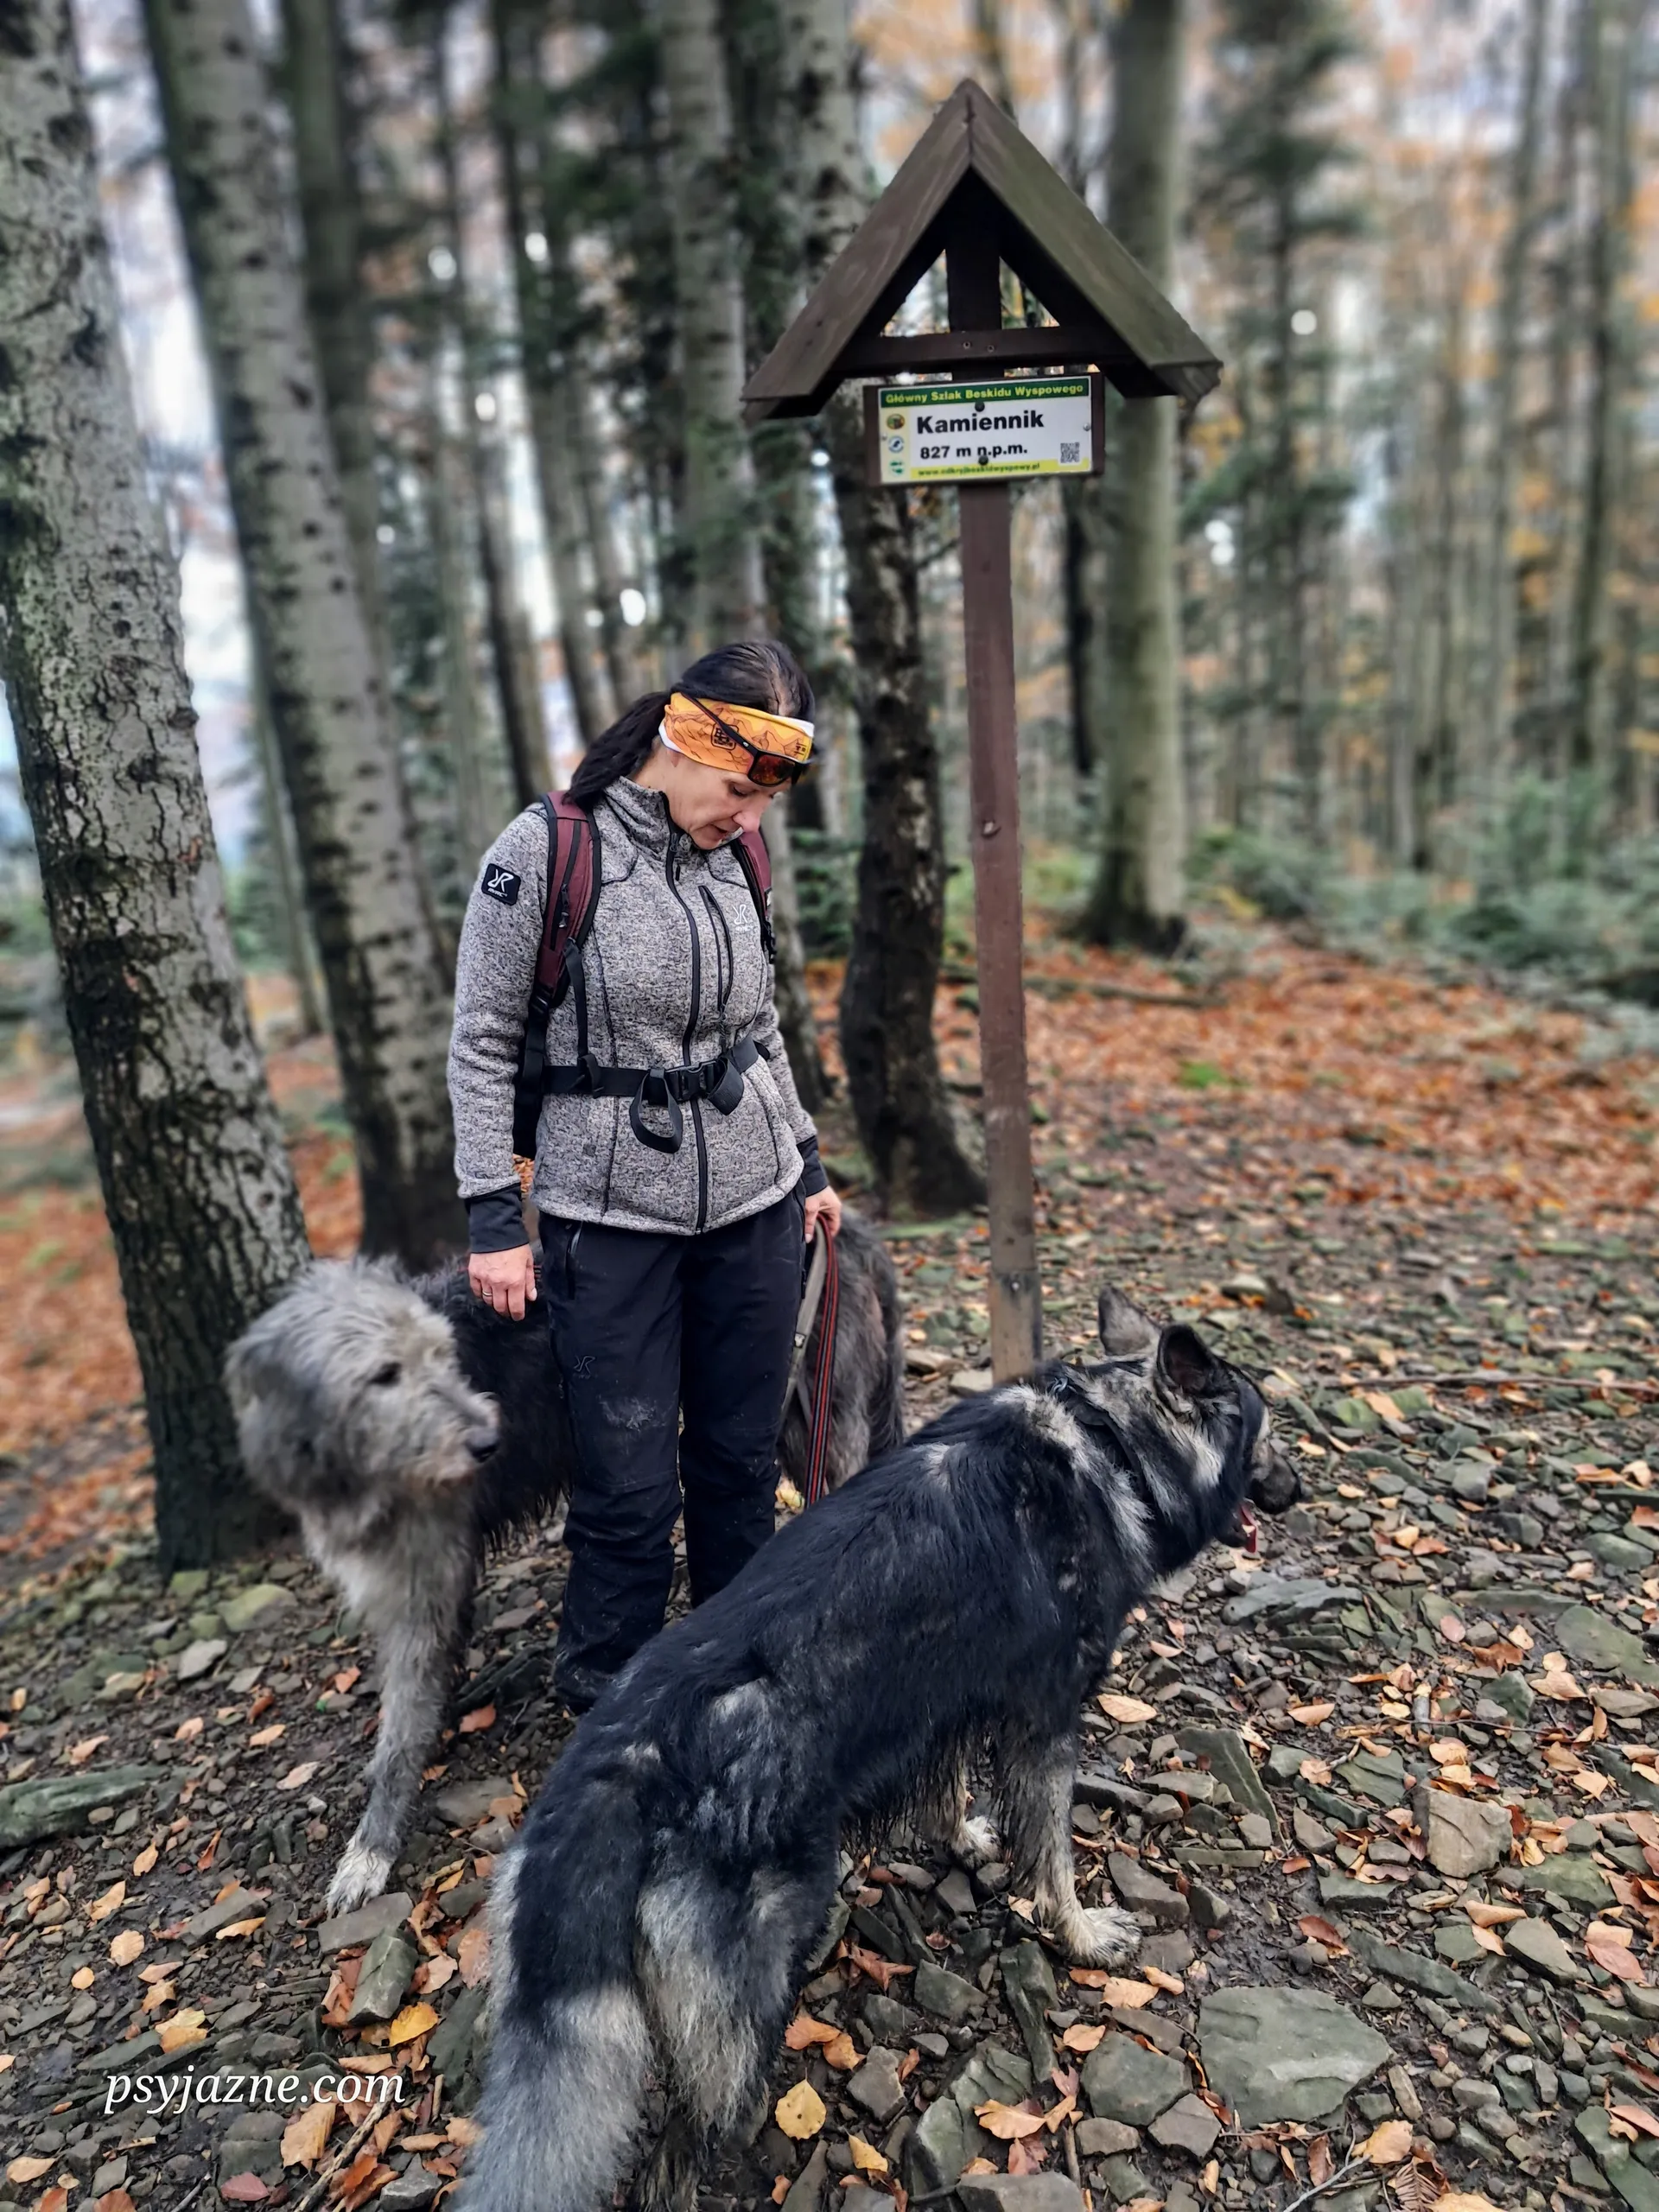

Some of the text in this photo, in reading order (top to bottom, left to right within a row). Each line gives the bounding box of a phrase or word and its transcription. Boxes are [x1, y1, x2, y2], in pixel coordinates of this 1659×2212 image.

[886, 385, 1084, 404] Główny Szlak Beskidu Wyspowego
[917, 410, 1044, 434] Kamiennik
[920, 443, 1027, 460] 827 m n.p.m.
